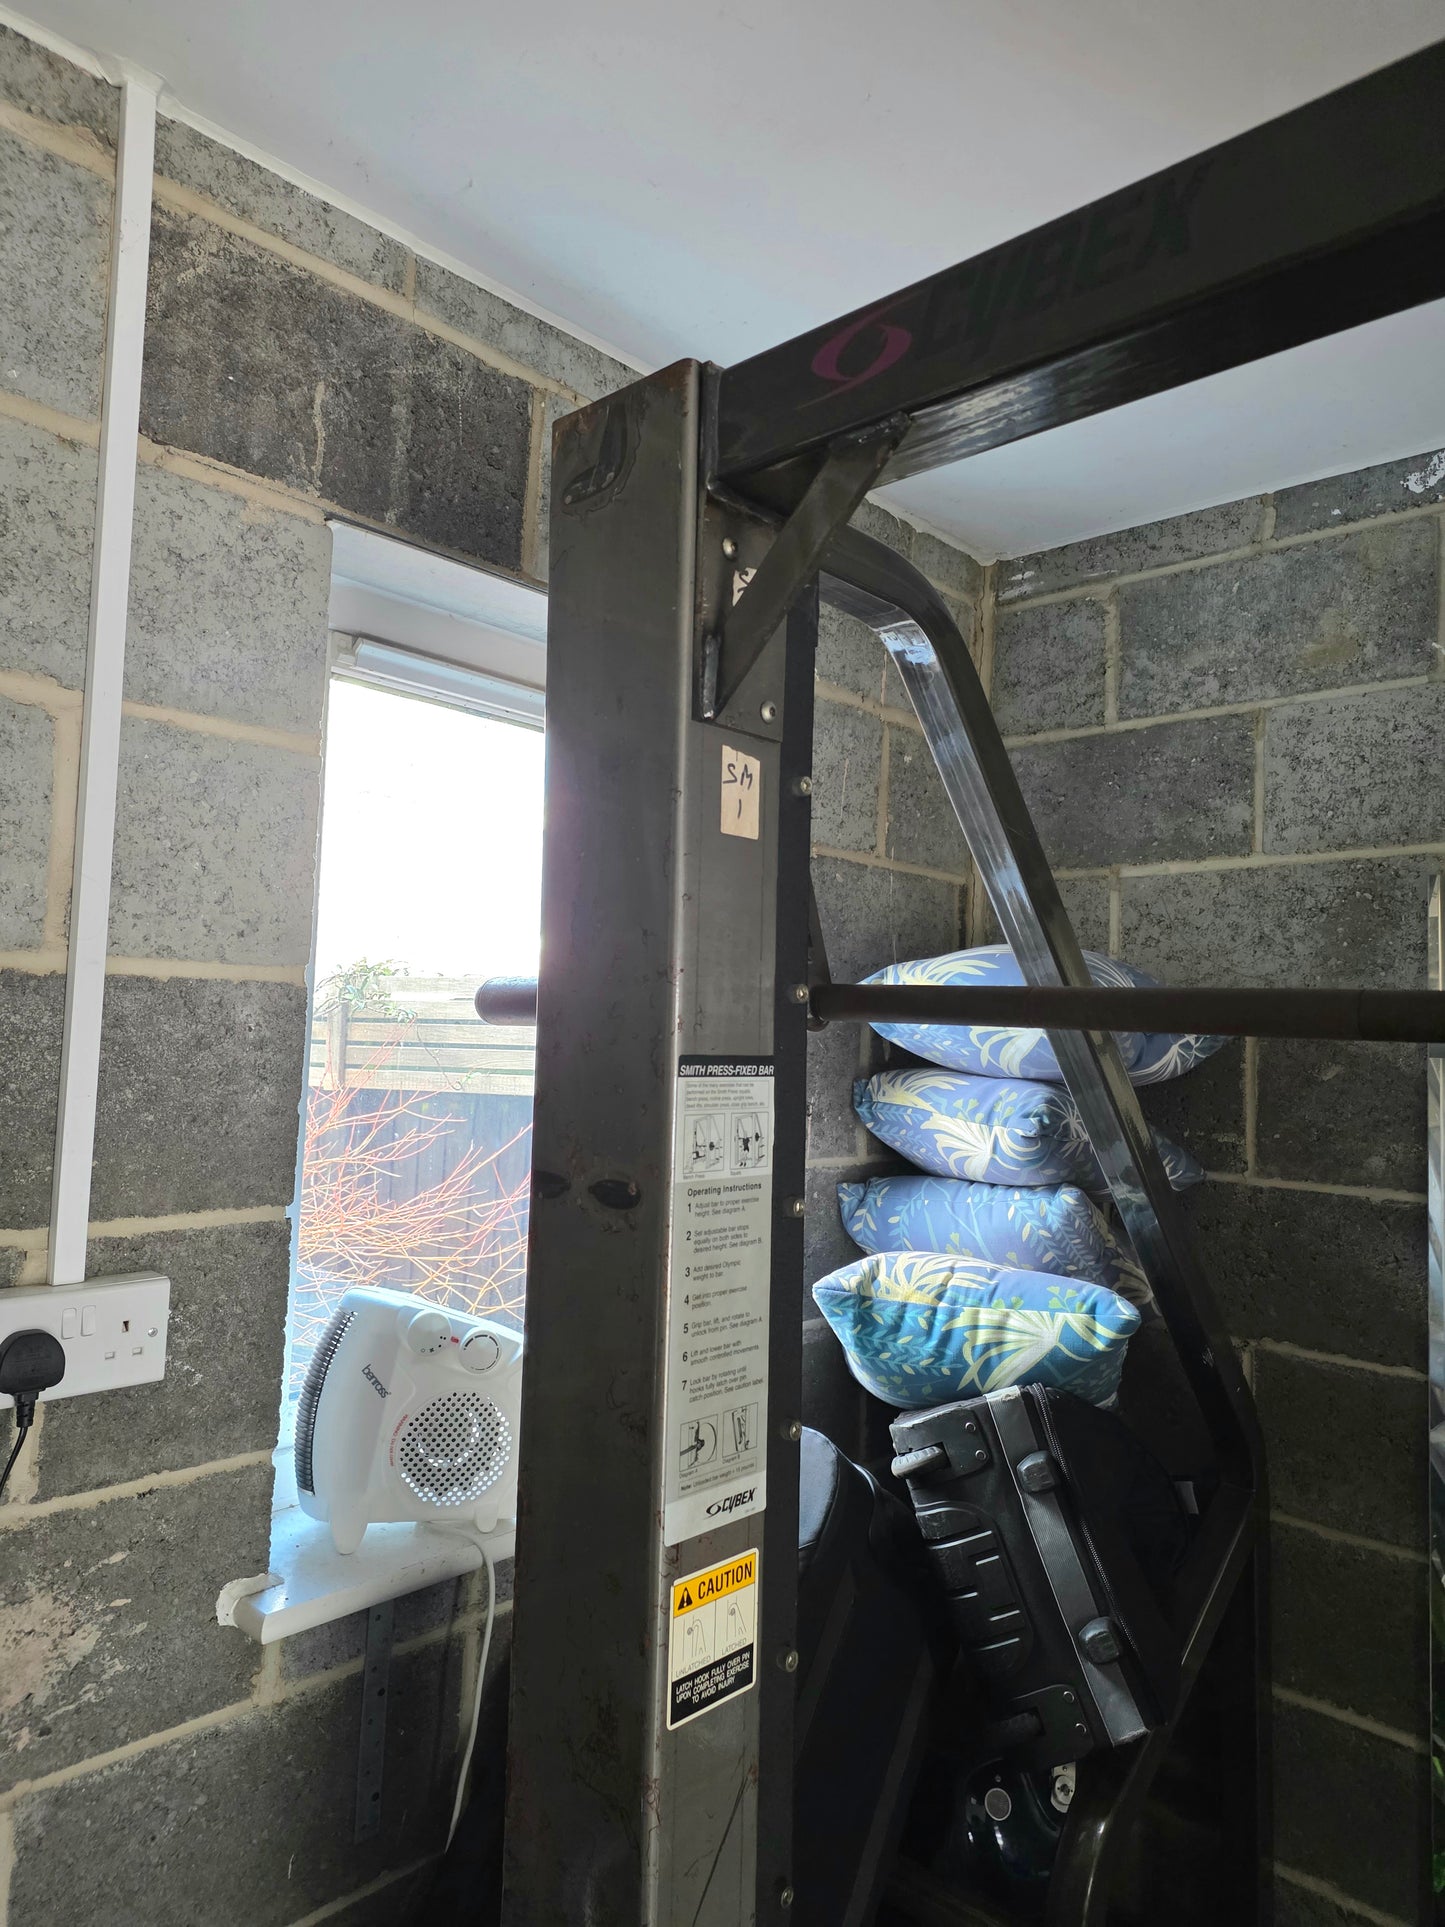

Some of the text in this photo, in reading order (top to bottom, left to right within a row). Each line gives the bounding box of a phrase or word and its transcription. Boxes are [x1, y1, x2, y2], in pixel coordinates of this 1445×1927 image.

[722, 763, 752, 790] SM
[680, 1065, 774, 1076] SMITH PRESS-FIXED BAR
[688, 1183, 761, 1197] Operating Instructions
[688, 1203, 691, 1212] 1
[686, 1231, 691, 1240] 2
[685, 1267, 690, 1277] 3
[684, 1295, 689, 1305] 4
[684, 1323, 688, 1334] 5
[682, 1351, 688, 1362] 6
[362, 1363, 388, 1398] benross
[682, 1380, 687, 1390] 7
[722, 1488, 755, 1513] CYBEX
[698, 1561, 752, 1599] CAUTION
[722, 1638, 747, 1655] LATCHED
[676, 1655, 711, 1677] UNLATCHED
[676, 1651, 750, 1695] LATCH HOOK FULLY OVER PIN
[677, 1660, 749, 1703] UPON COMPLETING EXERCISE
[692, 1676, 735, 1704] TO AVOID INJURY
